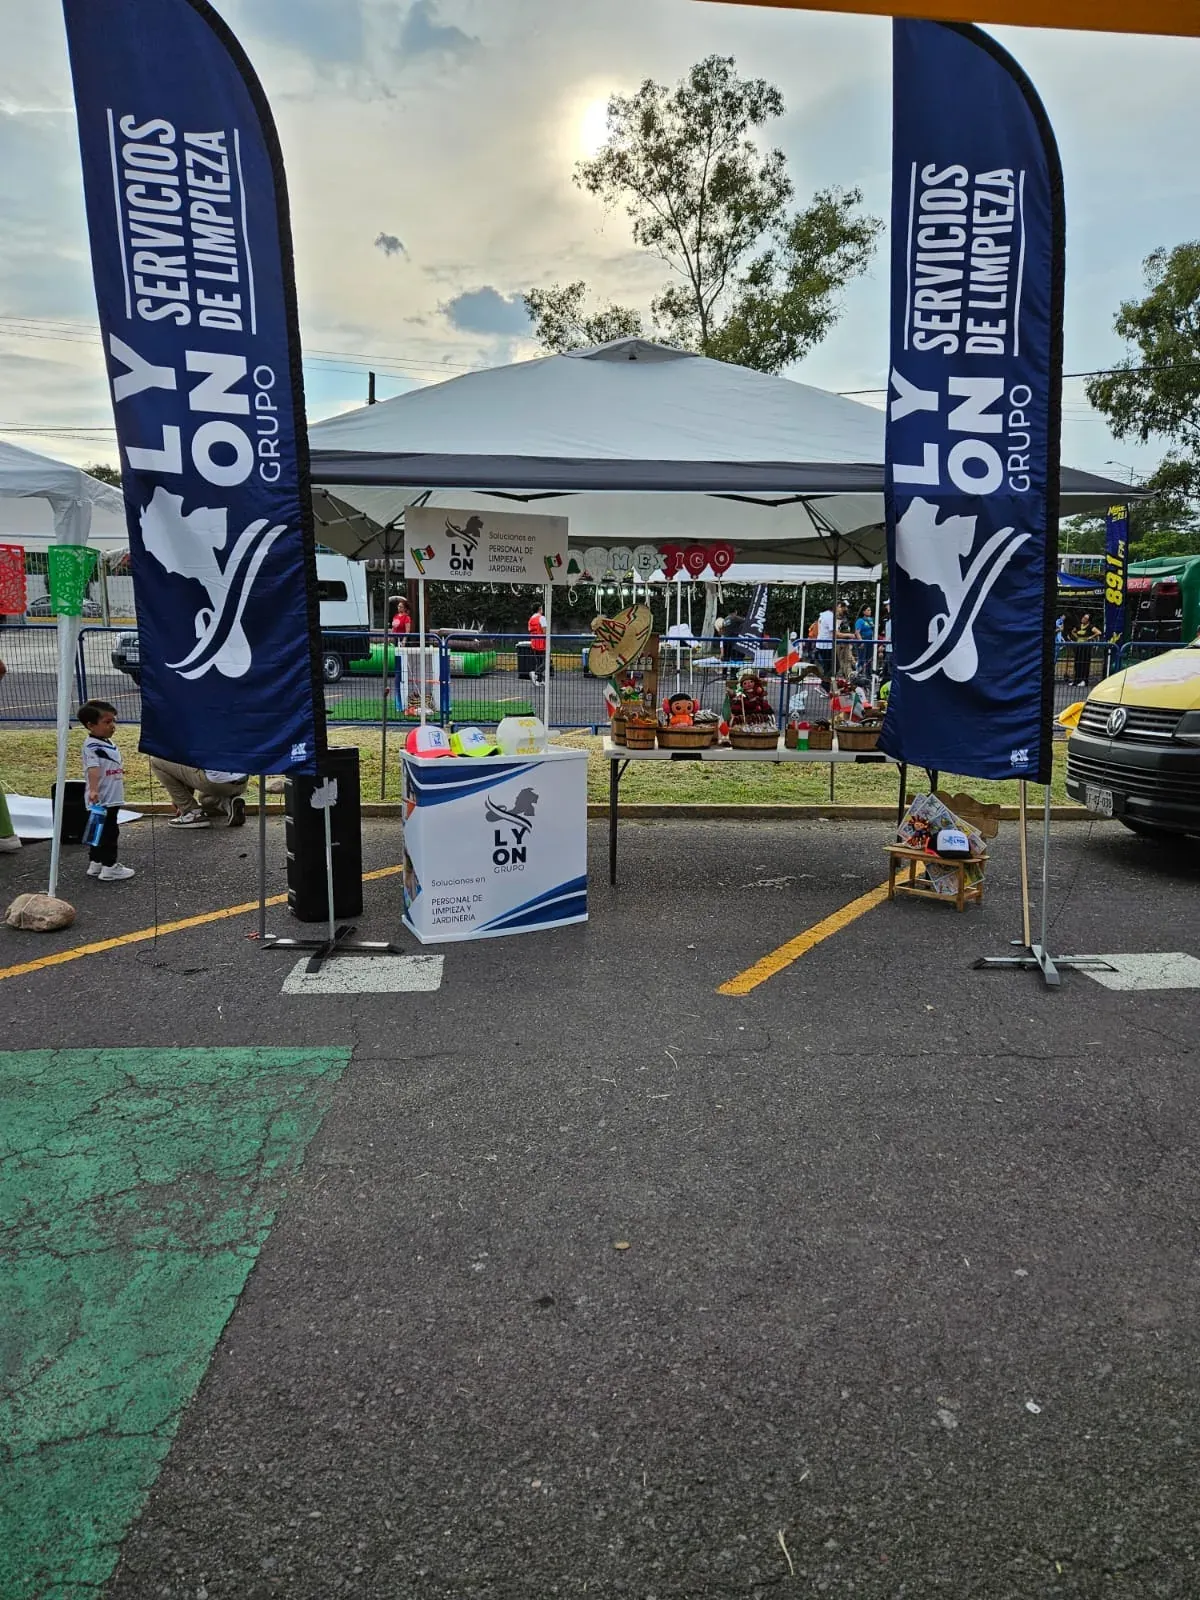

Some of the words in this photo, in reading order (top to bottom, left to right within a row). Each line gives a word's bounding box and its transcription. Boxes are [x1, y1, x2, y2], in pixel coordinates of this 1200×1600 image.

[119, 114, 191, 326] SERVICIOS
[183, 130, 240, 286] LIMPIEZA
[912, 163, 969, 355] SERVICIOS
[968, 168, 1015, 309] LIMPIEZA
[196, 288, 243, 331] DE
[965, 317, 1007, 355] DE
[109, 333, 184, 474] LY
[185, 350, 254, 487] ON
[253, 364, 281, 483] GRUPO
[890, 366, 940, 486] LY
[947, 376, 1005, 496] ON
[1007, 384, 1032, 493] GRUPO
[449, 558, 474, 571] ON
[488, 544, 523, 554] PERSONAL
[524, 546, 534, 555] DE
[488, 553, 518, 564] LIMPIEZA
[612, 550, 730, 571] MEXICO
[1105, 554, 1124, 606] 89.1
[1117, 540, 1126, 559] FM
[492, 846, 527, 866] ON
[494, 827, 528, 847] LY
[431, 878, 474, 887] Soluciones
[493, 864, 525, 874] GRUPO
[431, 895, 471, 906] PERSONAL
[472, 894, 483, 902] DE
[432, 905, 465, 916] LIMPIEZA
